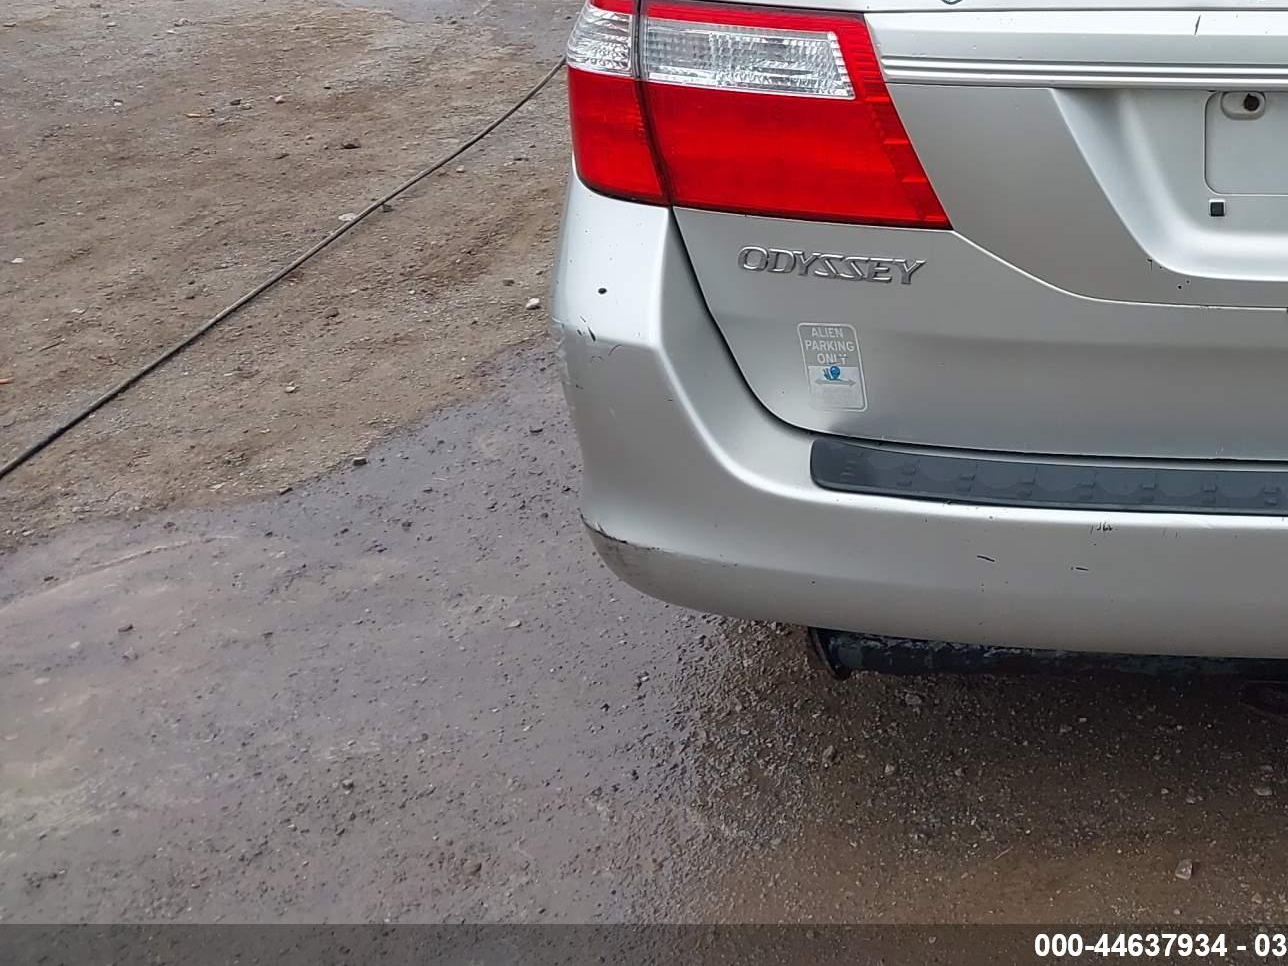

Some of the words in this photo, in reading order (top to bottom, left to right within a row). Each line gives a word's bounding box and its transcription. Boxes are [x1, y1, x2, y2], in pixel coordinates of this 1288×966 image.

[738, 246, 927, 285] ODYSSEY
[811, 327, 844, 338] ALIEN
[804, 339, 856, 352] PARKING
